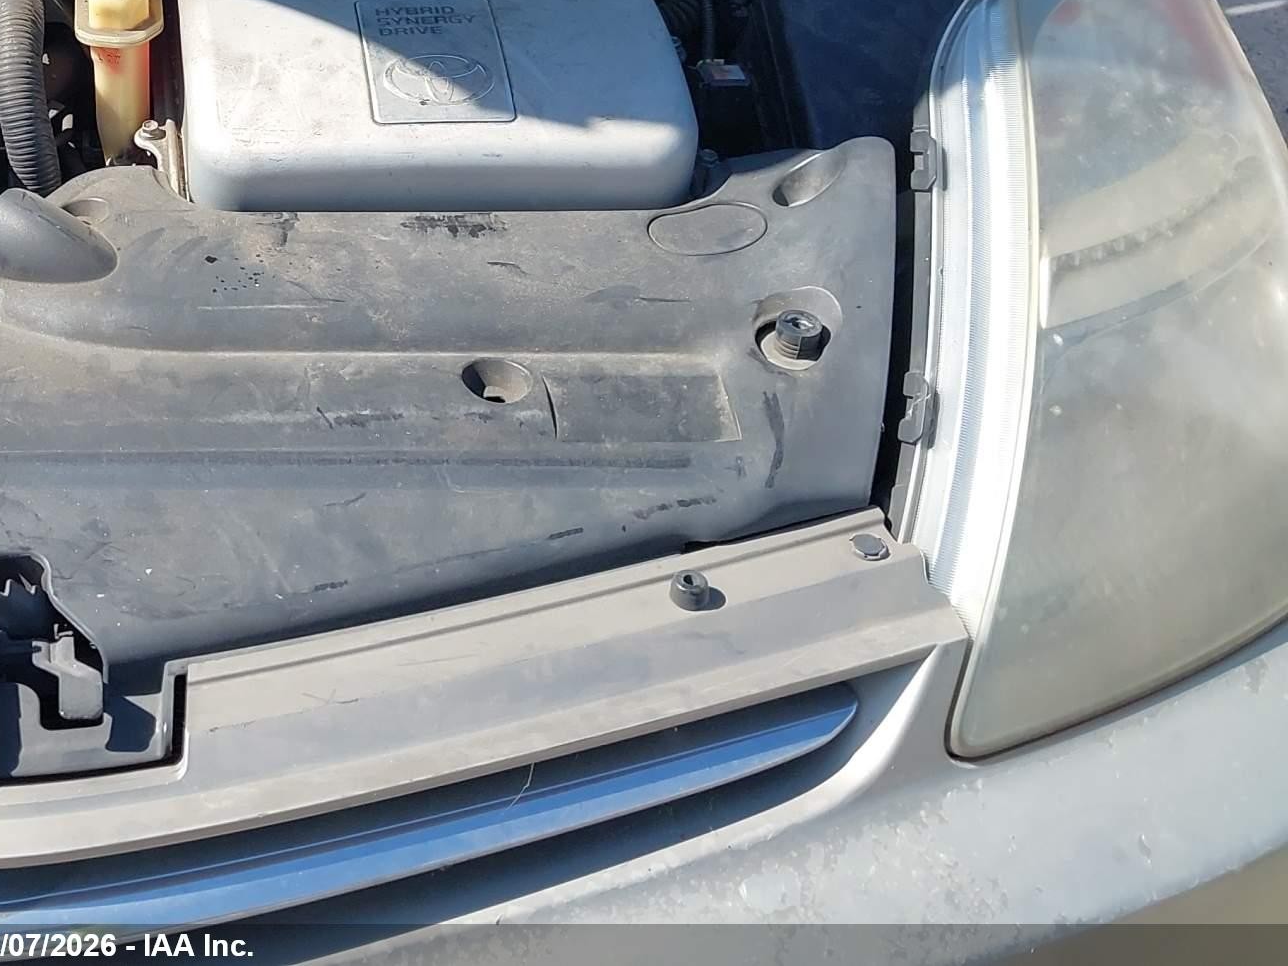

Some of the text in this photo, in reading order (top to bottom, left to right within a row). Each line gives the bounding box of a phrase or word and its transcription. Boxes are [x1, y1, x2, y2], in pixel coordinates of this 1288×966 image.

[376, 5, 455, 17] HYBRID
[377, 14, 476, 27] SYNERGY
[379, 25, 443, 36] DRIVE
